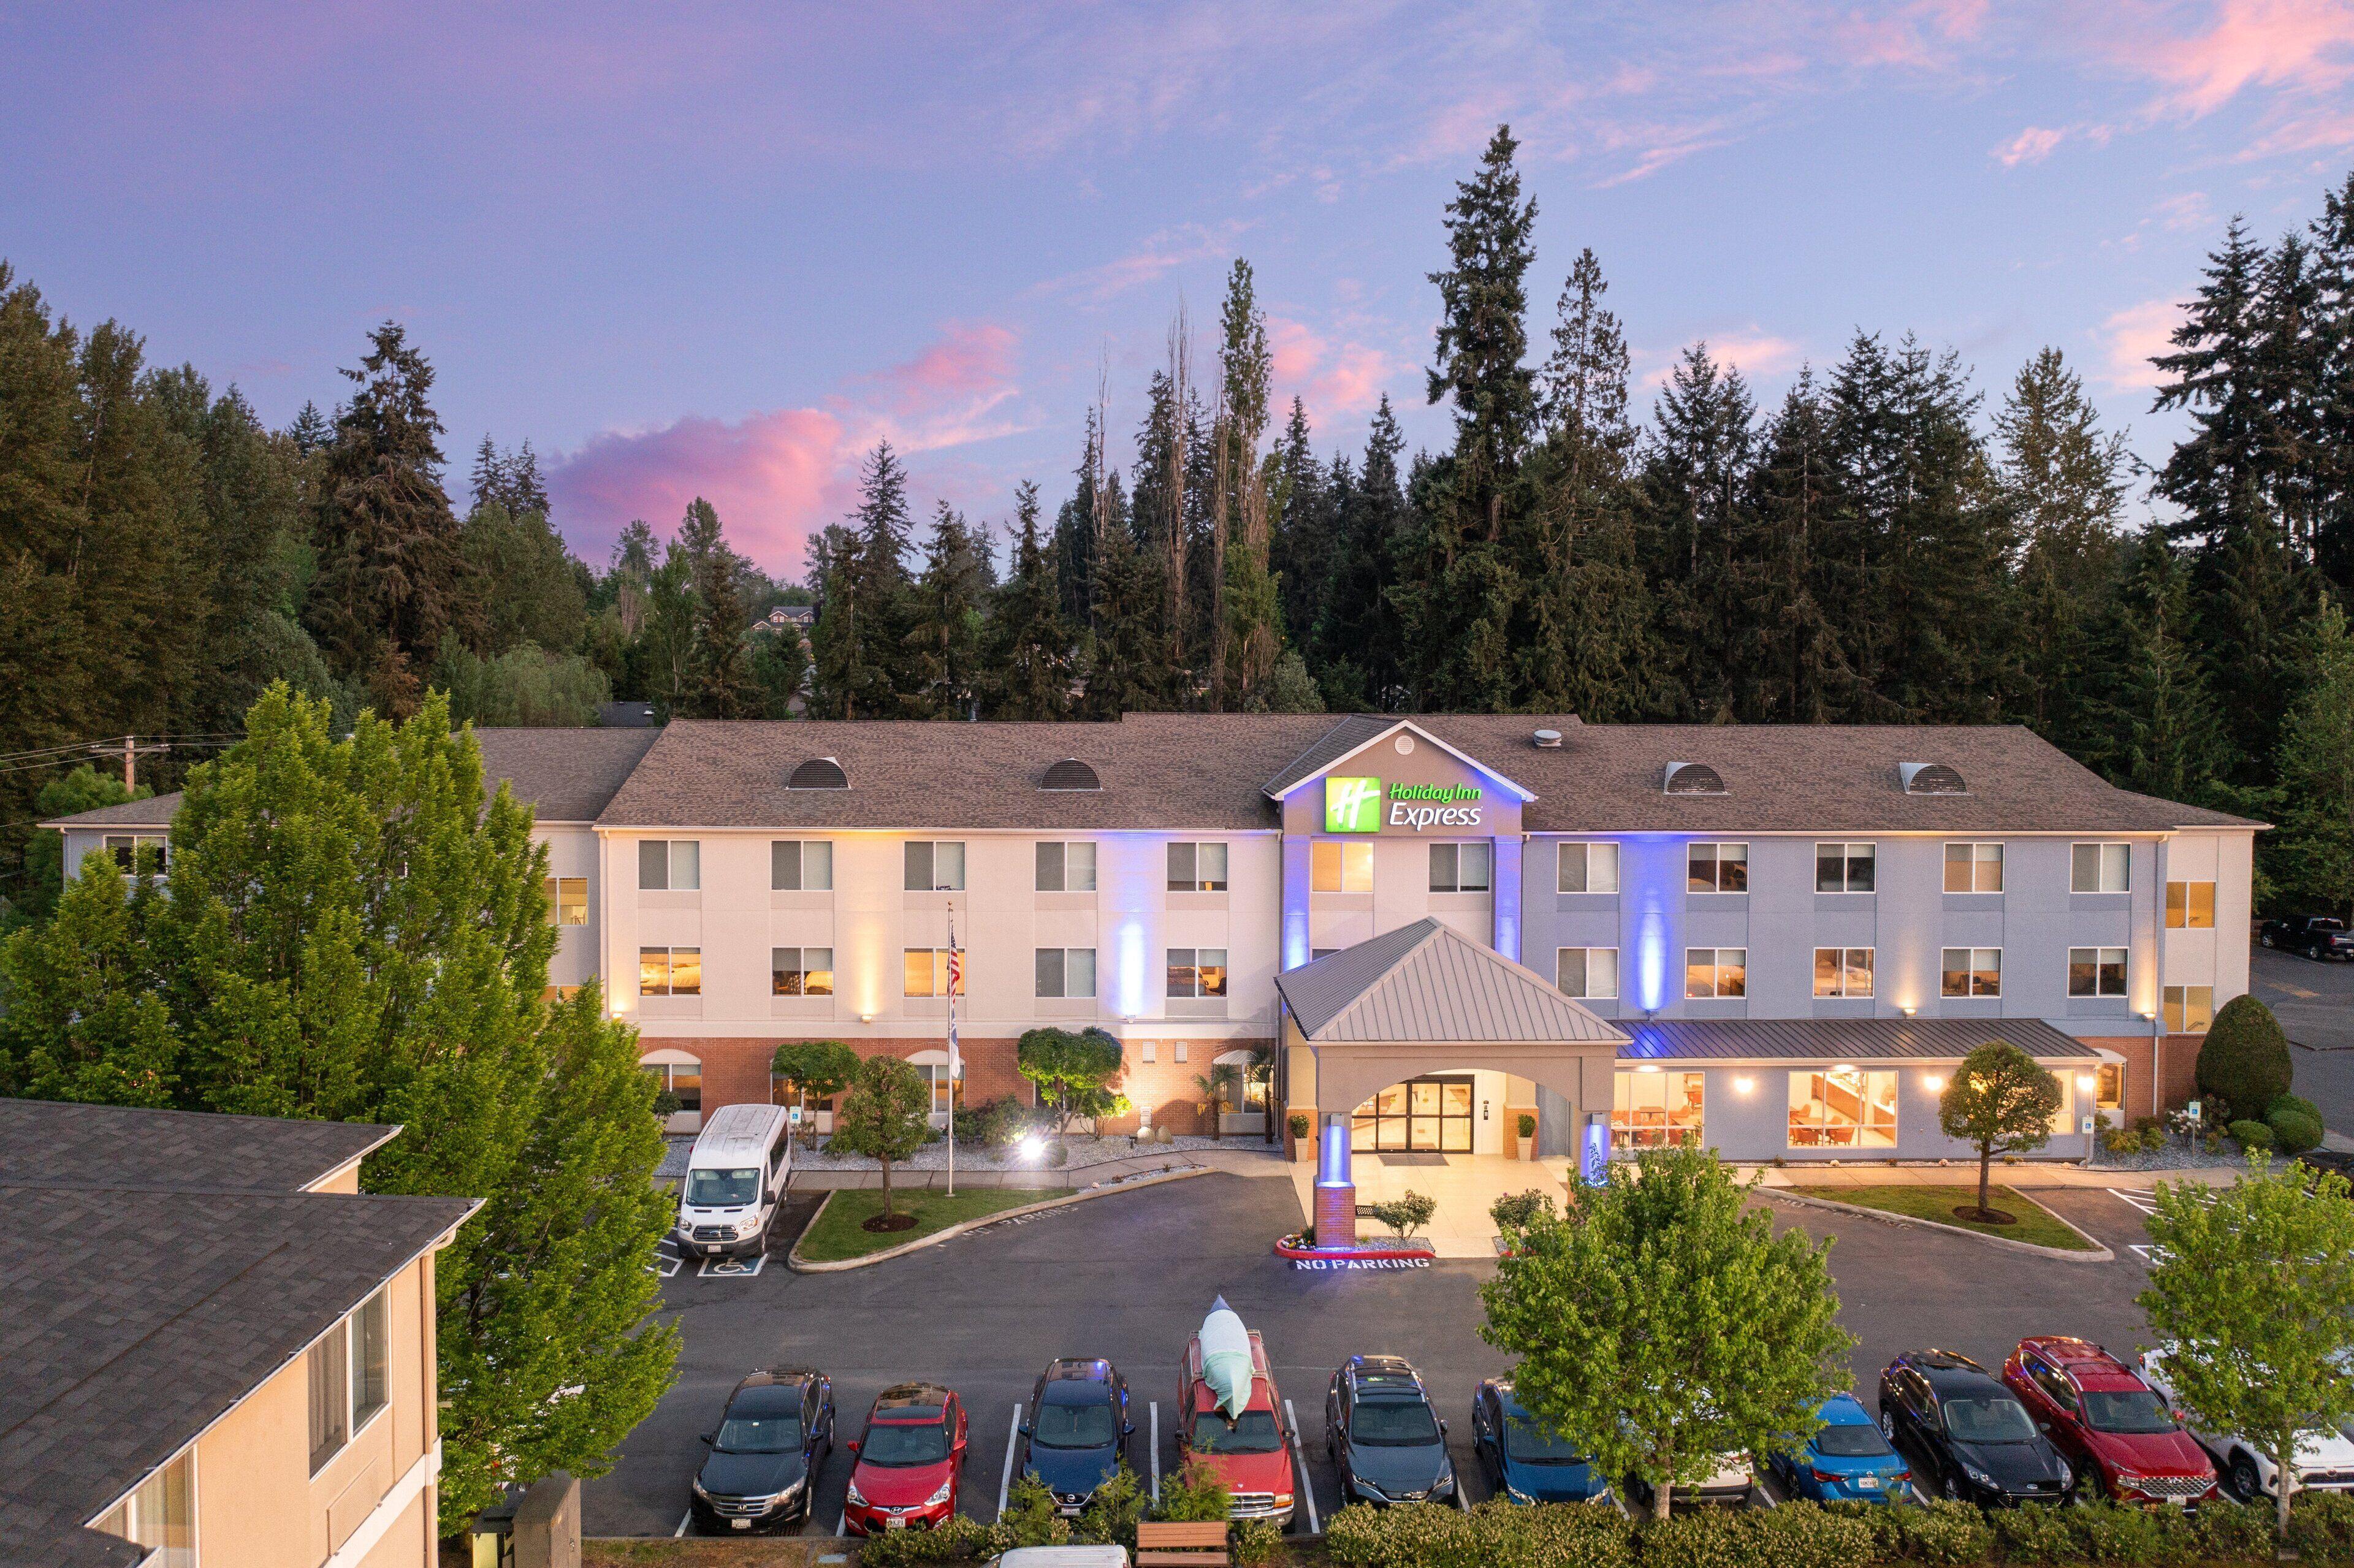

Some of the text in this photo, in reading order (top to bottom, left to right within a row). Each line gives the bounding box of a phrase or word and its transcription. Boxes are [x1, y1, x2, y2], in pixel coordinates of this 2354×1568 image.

[1388, 782, 1482, 804] Holiday Inn
[1389, 802, 1482, 831] Express
[1295, 1258, 1430, 1270] NO PARKING
